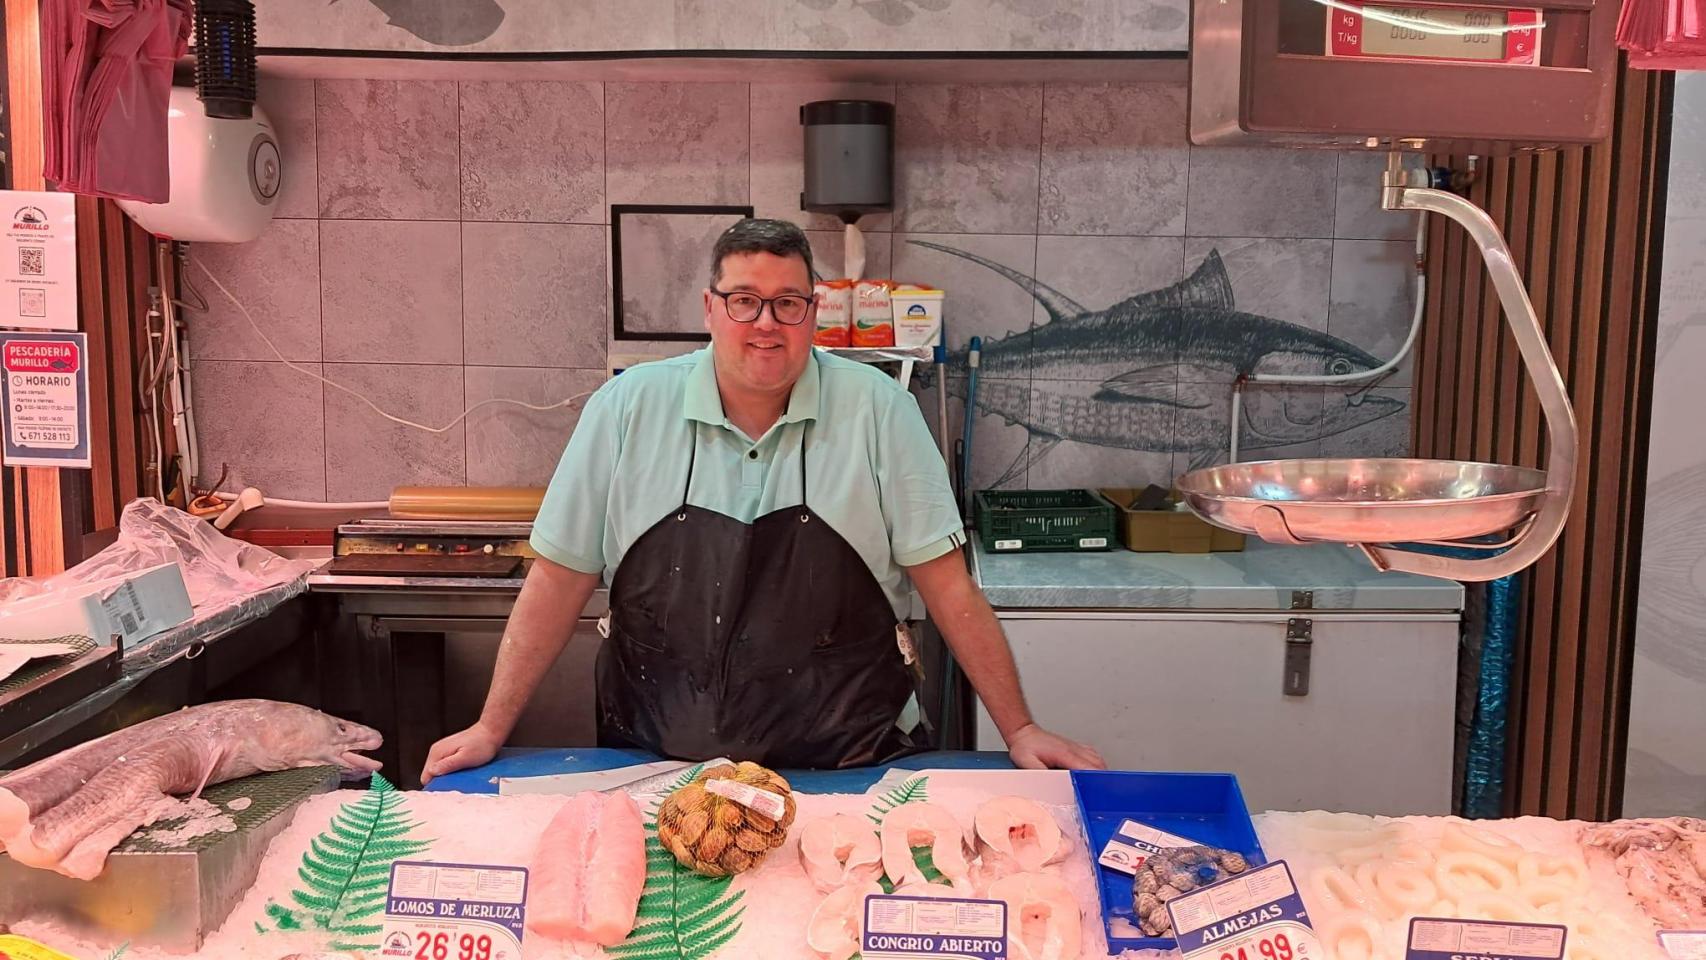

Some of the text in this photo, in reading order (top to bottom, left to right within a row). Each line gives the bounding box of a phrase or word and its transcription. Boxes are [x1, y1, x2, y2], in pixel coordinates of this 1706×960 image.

[1343, 14, 1354, 26] kg
[1337, 32, 1357, 45] T/kg
[13, 223, 49, 231] MURILLO
[10, 345, 71, 357] PESCADERÍA
[11, 357, 49, 367] MURILLO
[26, 376, 71, 386] HORARIO
[28, 432, 71, 441] 671 528 113
[391, 900, 521, 919] LOMOS DE MERLUZA
[1202, 904, 1284, 944] ALMEJAS
[868, 936, 1002, 953] CONGRIO ABIERTO
[382, 948, 413, 957] MURILLO
